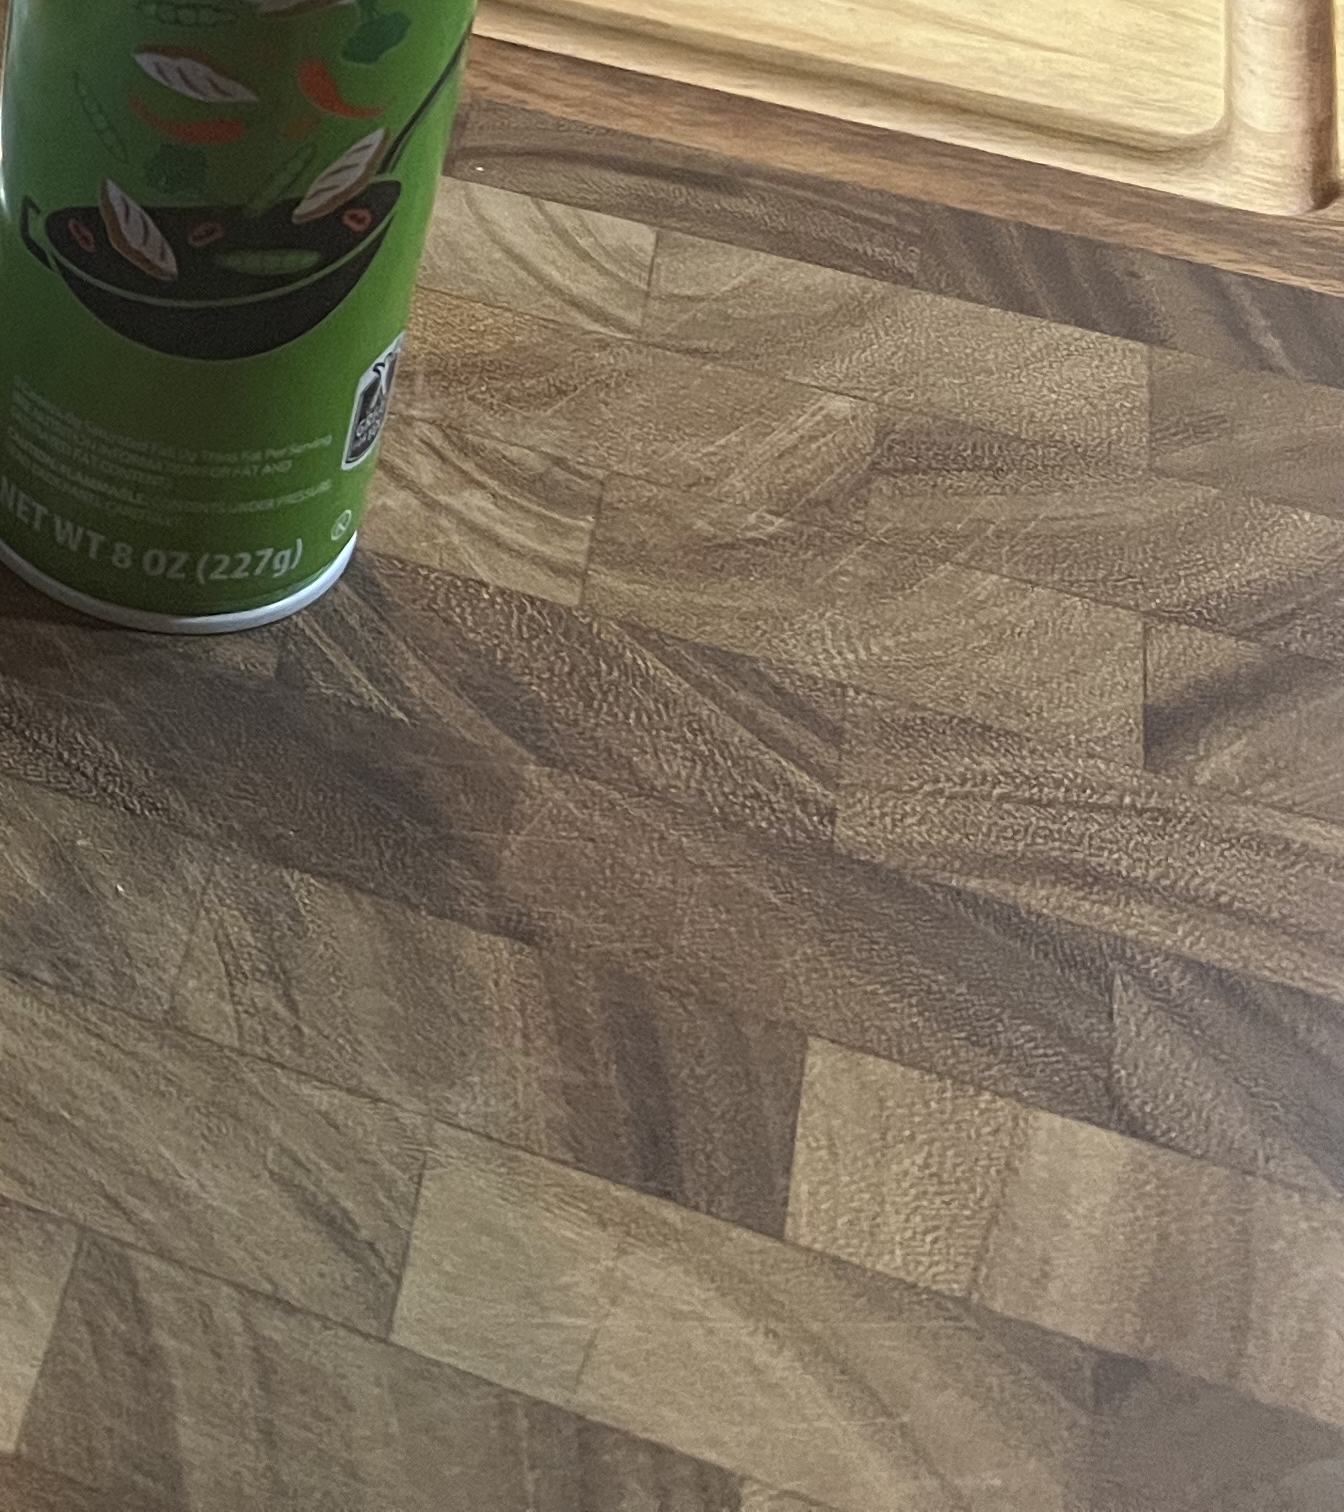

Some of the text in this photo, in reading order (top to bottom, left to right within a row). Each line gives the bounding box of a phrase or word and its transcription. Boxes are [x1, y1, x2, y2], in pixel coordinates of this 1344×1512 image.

[0, 475, 49, 531] NET
[54, 514, 107, 561] WT
[111, 542, 133, 571] 8
[143, 549, 188, 580] OZ
[196, 538, 303, 585] (227g)
